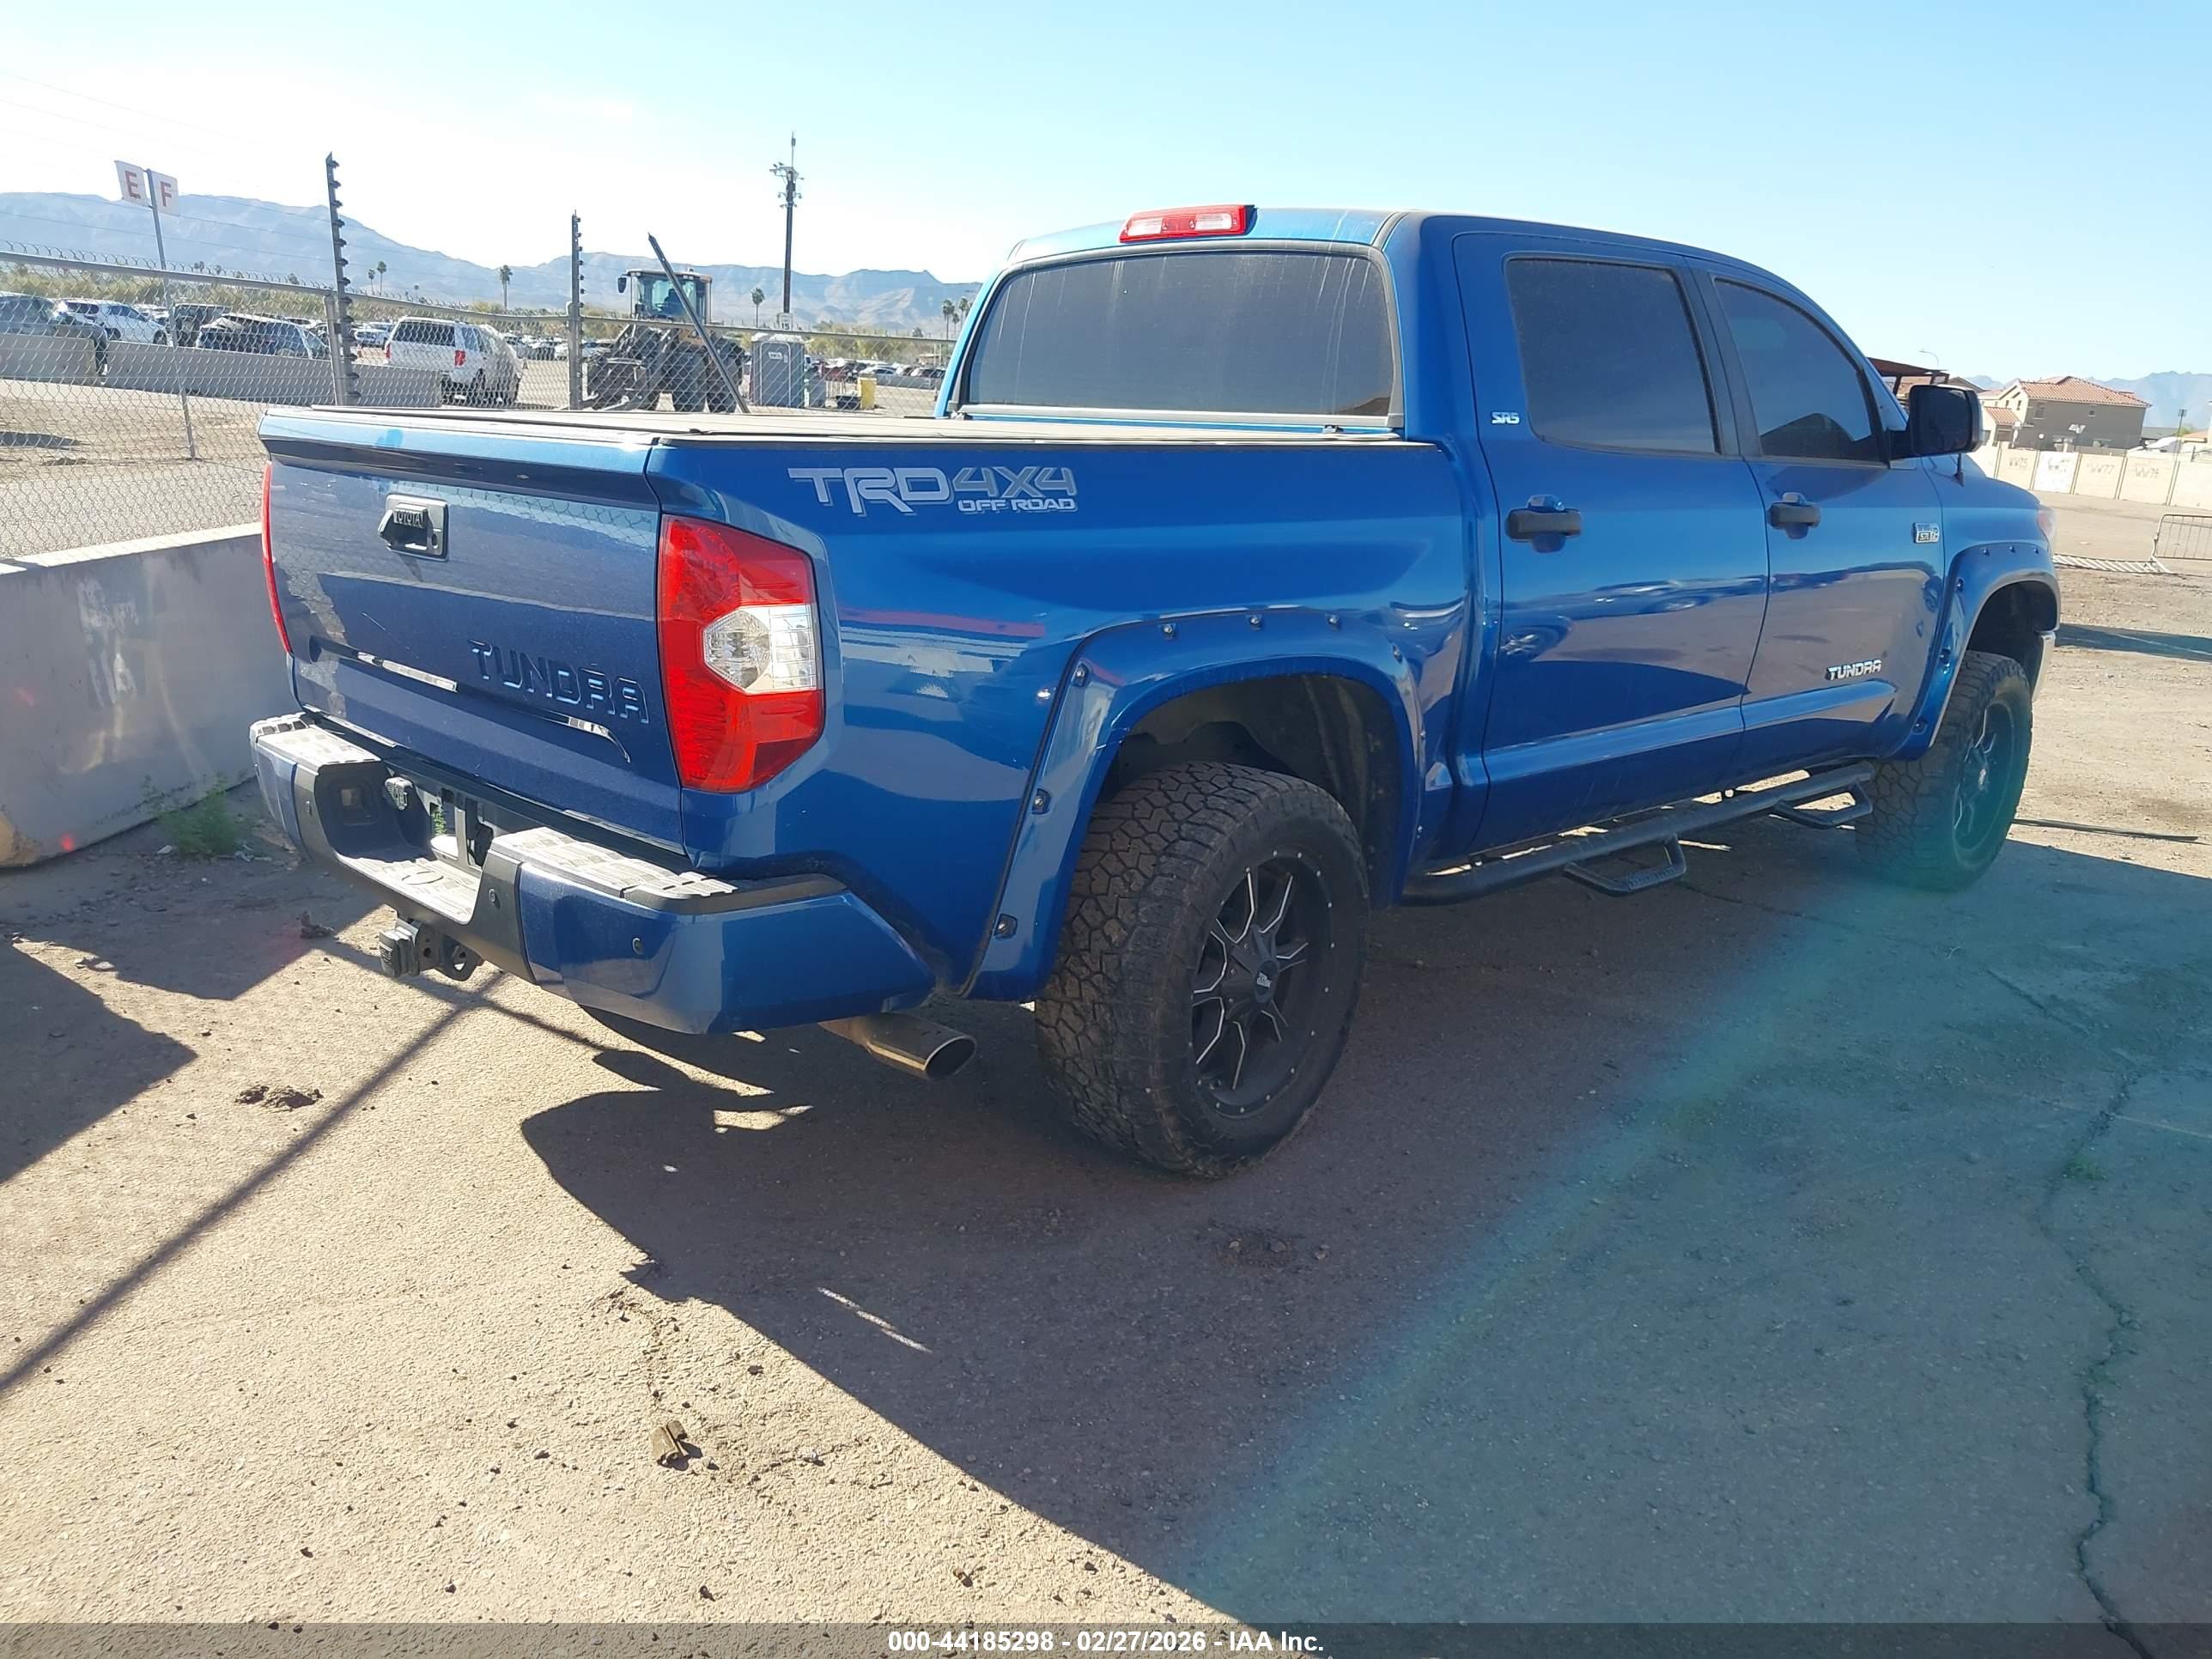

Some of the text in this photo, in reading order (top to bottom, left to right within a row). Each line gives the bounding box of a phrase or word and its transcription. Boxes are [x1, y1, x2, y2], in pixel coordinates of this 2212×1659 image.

[125, 170, 141, 199] E
[161, 181, 173, 206] F
[787, 466, 1078, 517] TRD 4X4
[393, 508, 424, 529] TOYOTA
[957, 498, 1078, 514] OFF ROAD
[468, 639, 650, 724] TUNDRA
[1826, 659, 1882, 681] TUNDRA
